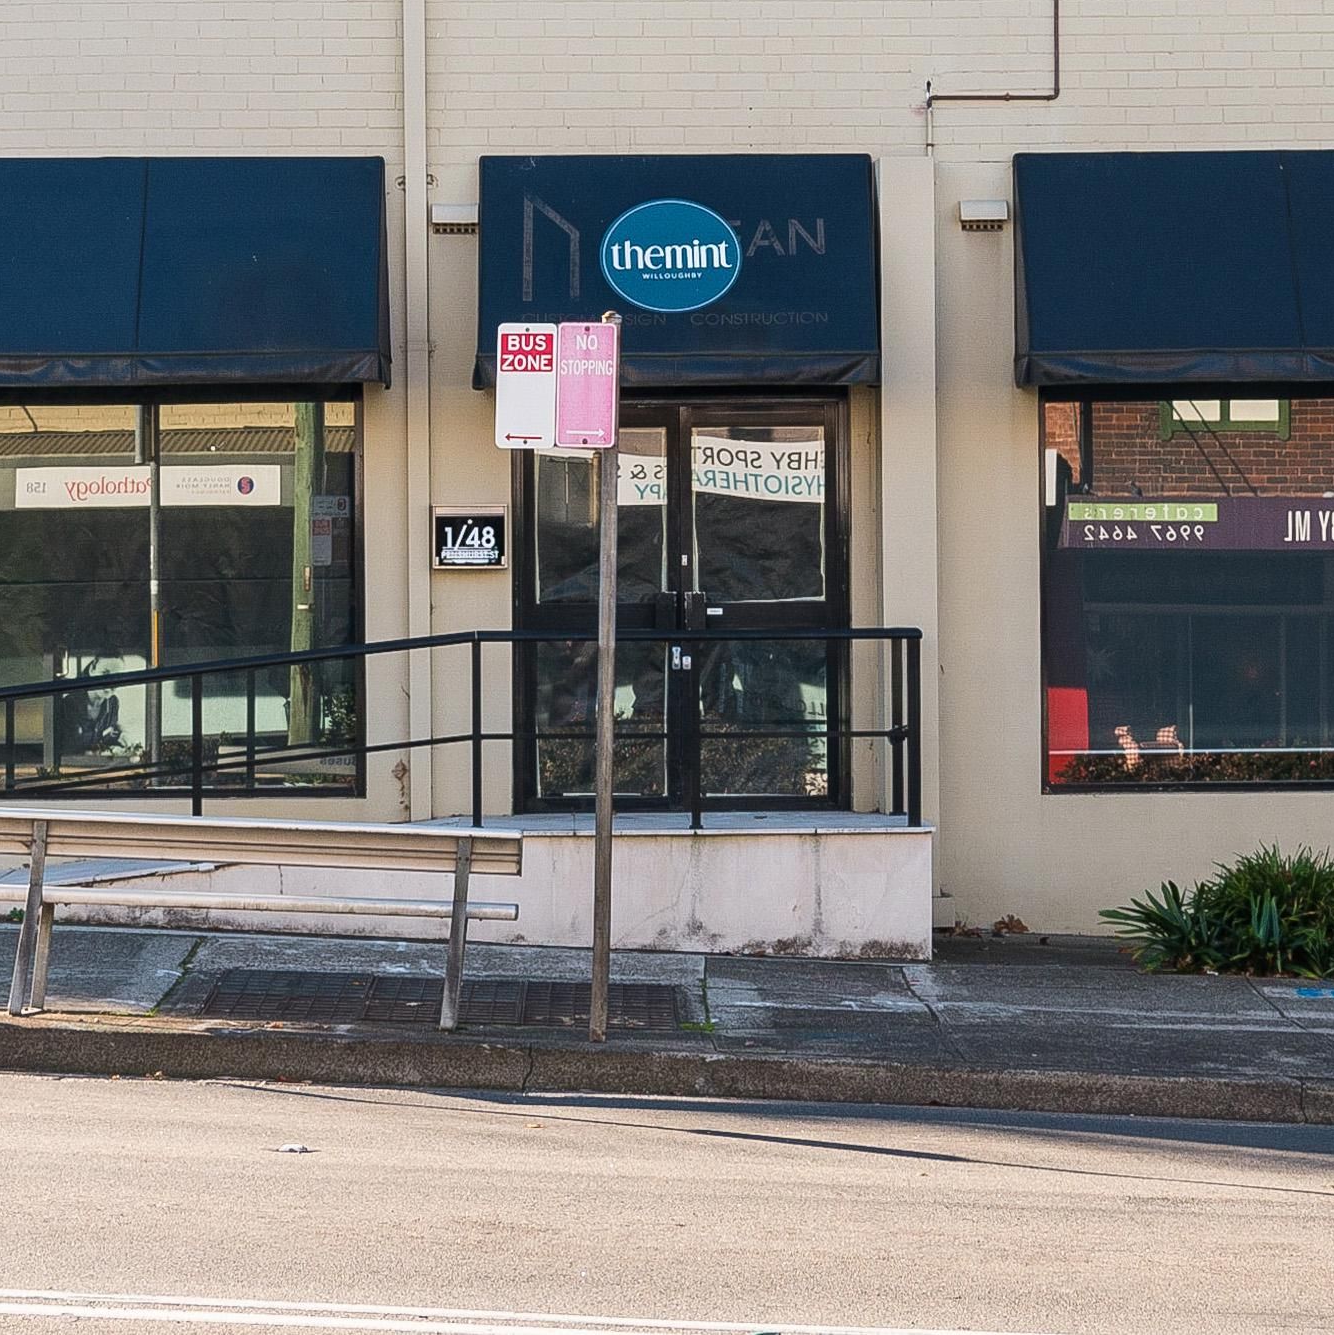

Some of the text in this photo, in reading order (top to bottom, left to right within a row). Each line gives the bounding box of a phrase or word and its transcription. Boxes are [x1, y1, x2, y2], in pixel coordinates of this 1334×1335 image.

[611, 239, 733, 271] themint
[642, 272, 703, 280] WILLOUGHBY
[690, 312, 829, 326] CONSTRUCTION
[507, 335, 547, 351] BUS
[575, 335, 599, 351] NO
[501, 355, 553, 372] ZONE
[560, 360, 614, 377] STOPPING
[444, 524, 496, 550] 1/48
